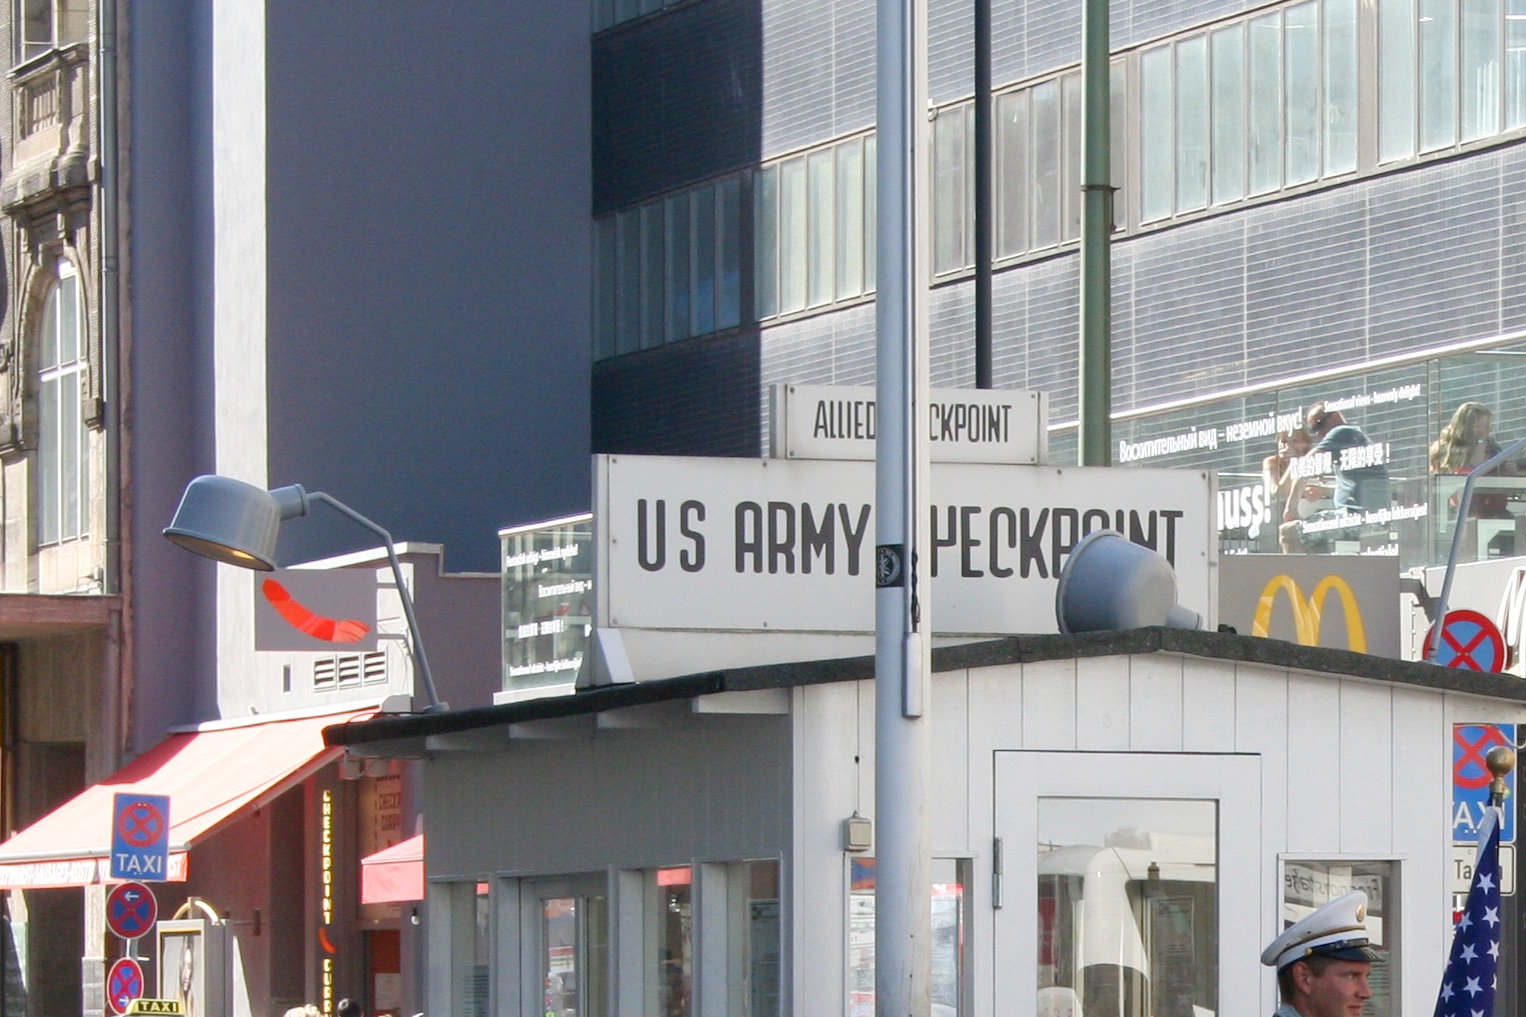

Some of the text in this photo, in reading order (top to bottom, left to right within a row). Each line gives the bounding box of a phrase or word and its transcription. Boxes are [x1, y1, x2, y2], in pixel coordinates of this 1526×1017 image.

[1199, 428, 1218, 450] вид
[1226, 412, 1276, 443] неземной
[1277, 405, 1303, 437] вкус!
[734, 500, 872, 576] ARMY
[116, 853, 162, 874] TAXI
[322, 789, 333, 925] CHECKPOINT
[140, 1001, 177, 1013] TAXI
